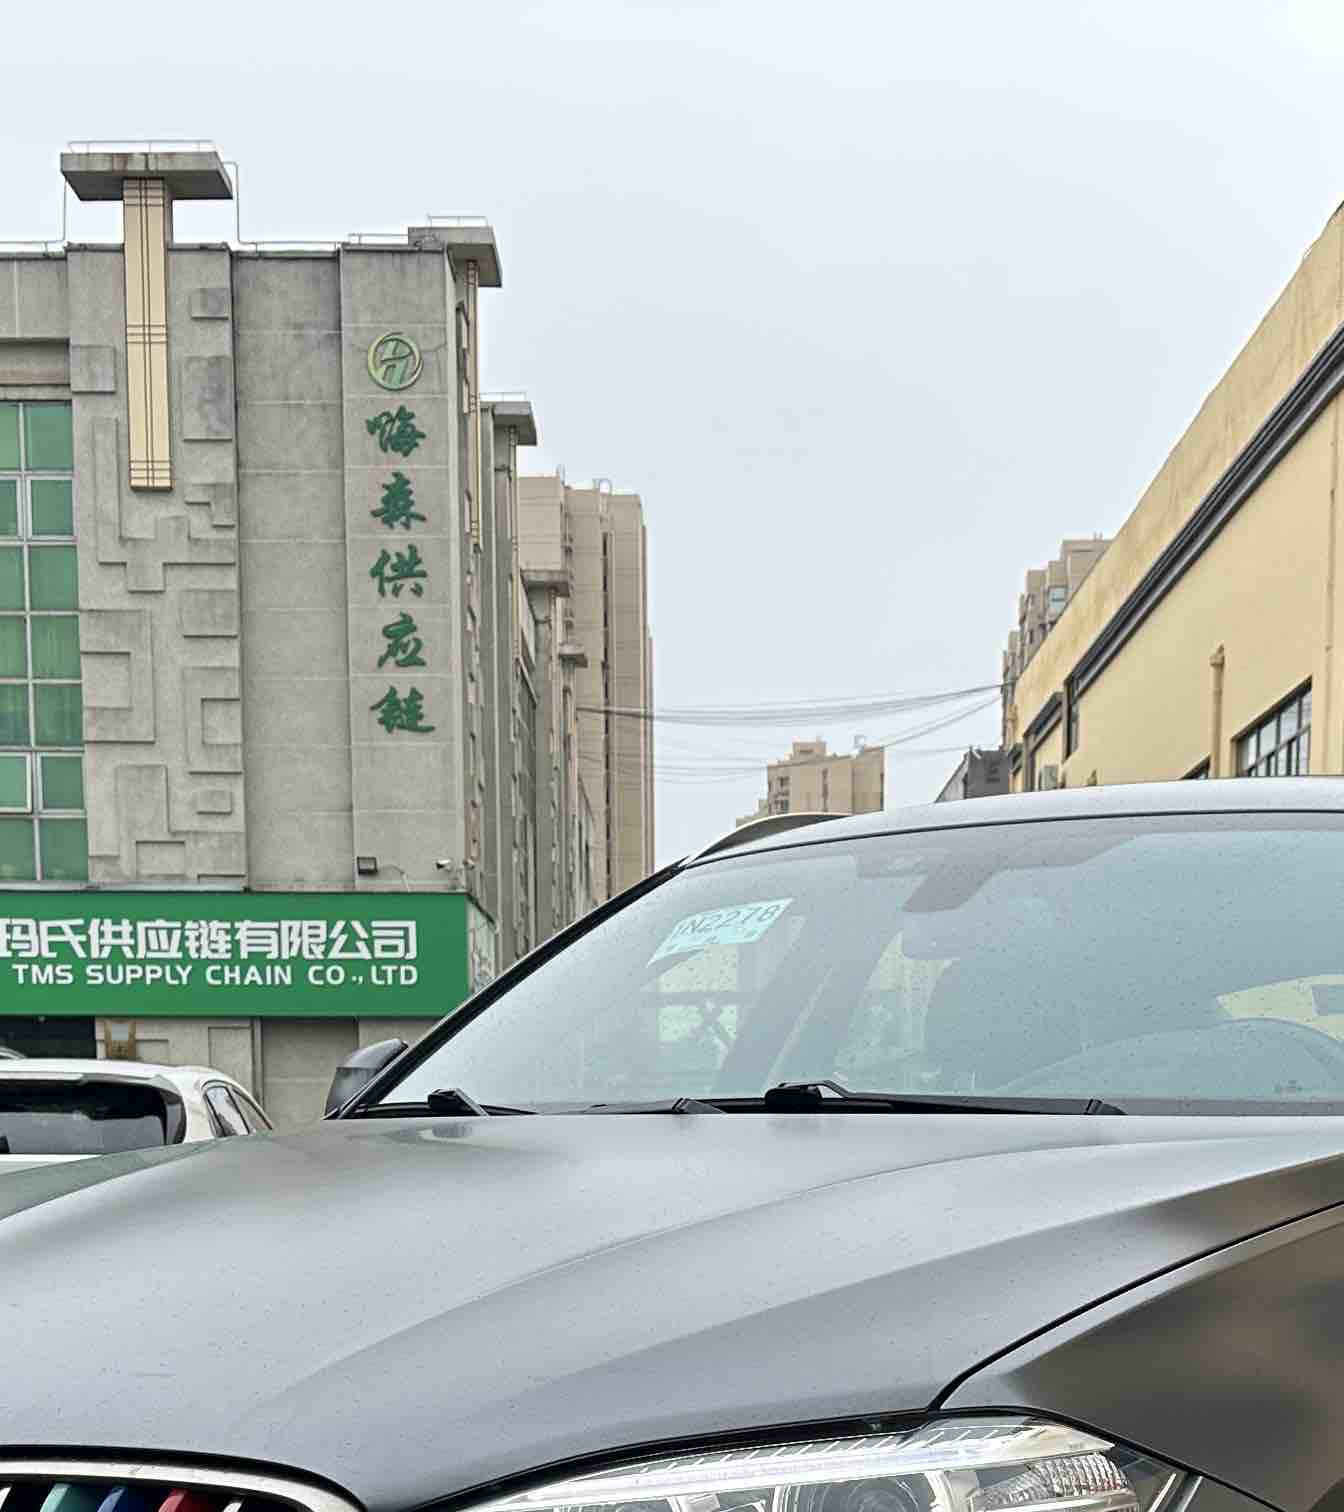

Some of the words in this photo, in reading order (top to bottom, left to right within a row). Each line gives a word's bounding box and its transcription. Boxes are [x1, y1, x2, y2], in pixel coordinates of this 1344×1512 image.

[12, 963, 74, 985] TMS
[85, 964, 193, 986] SUPPLY
[205, 964, 293, 986] CHAIN
